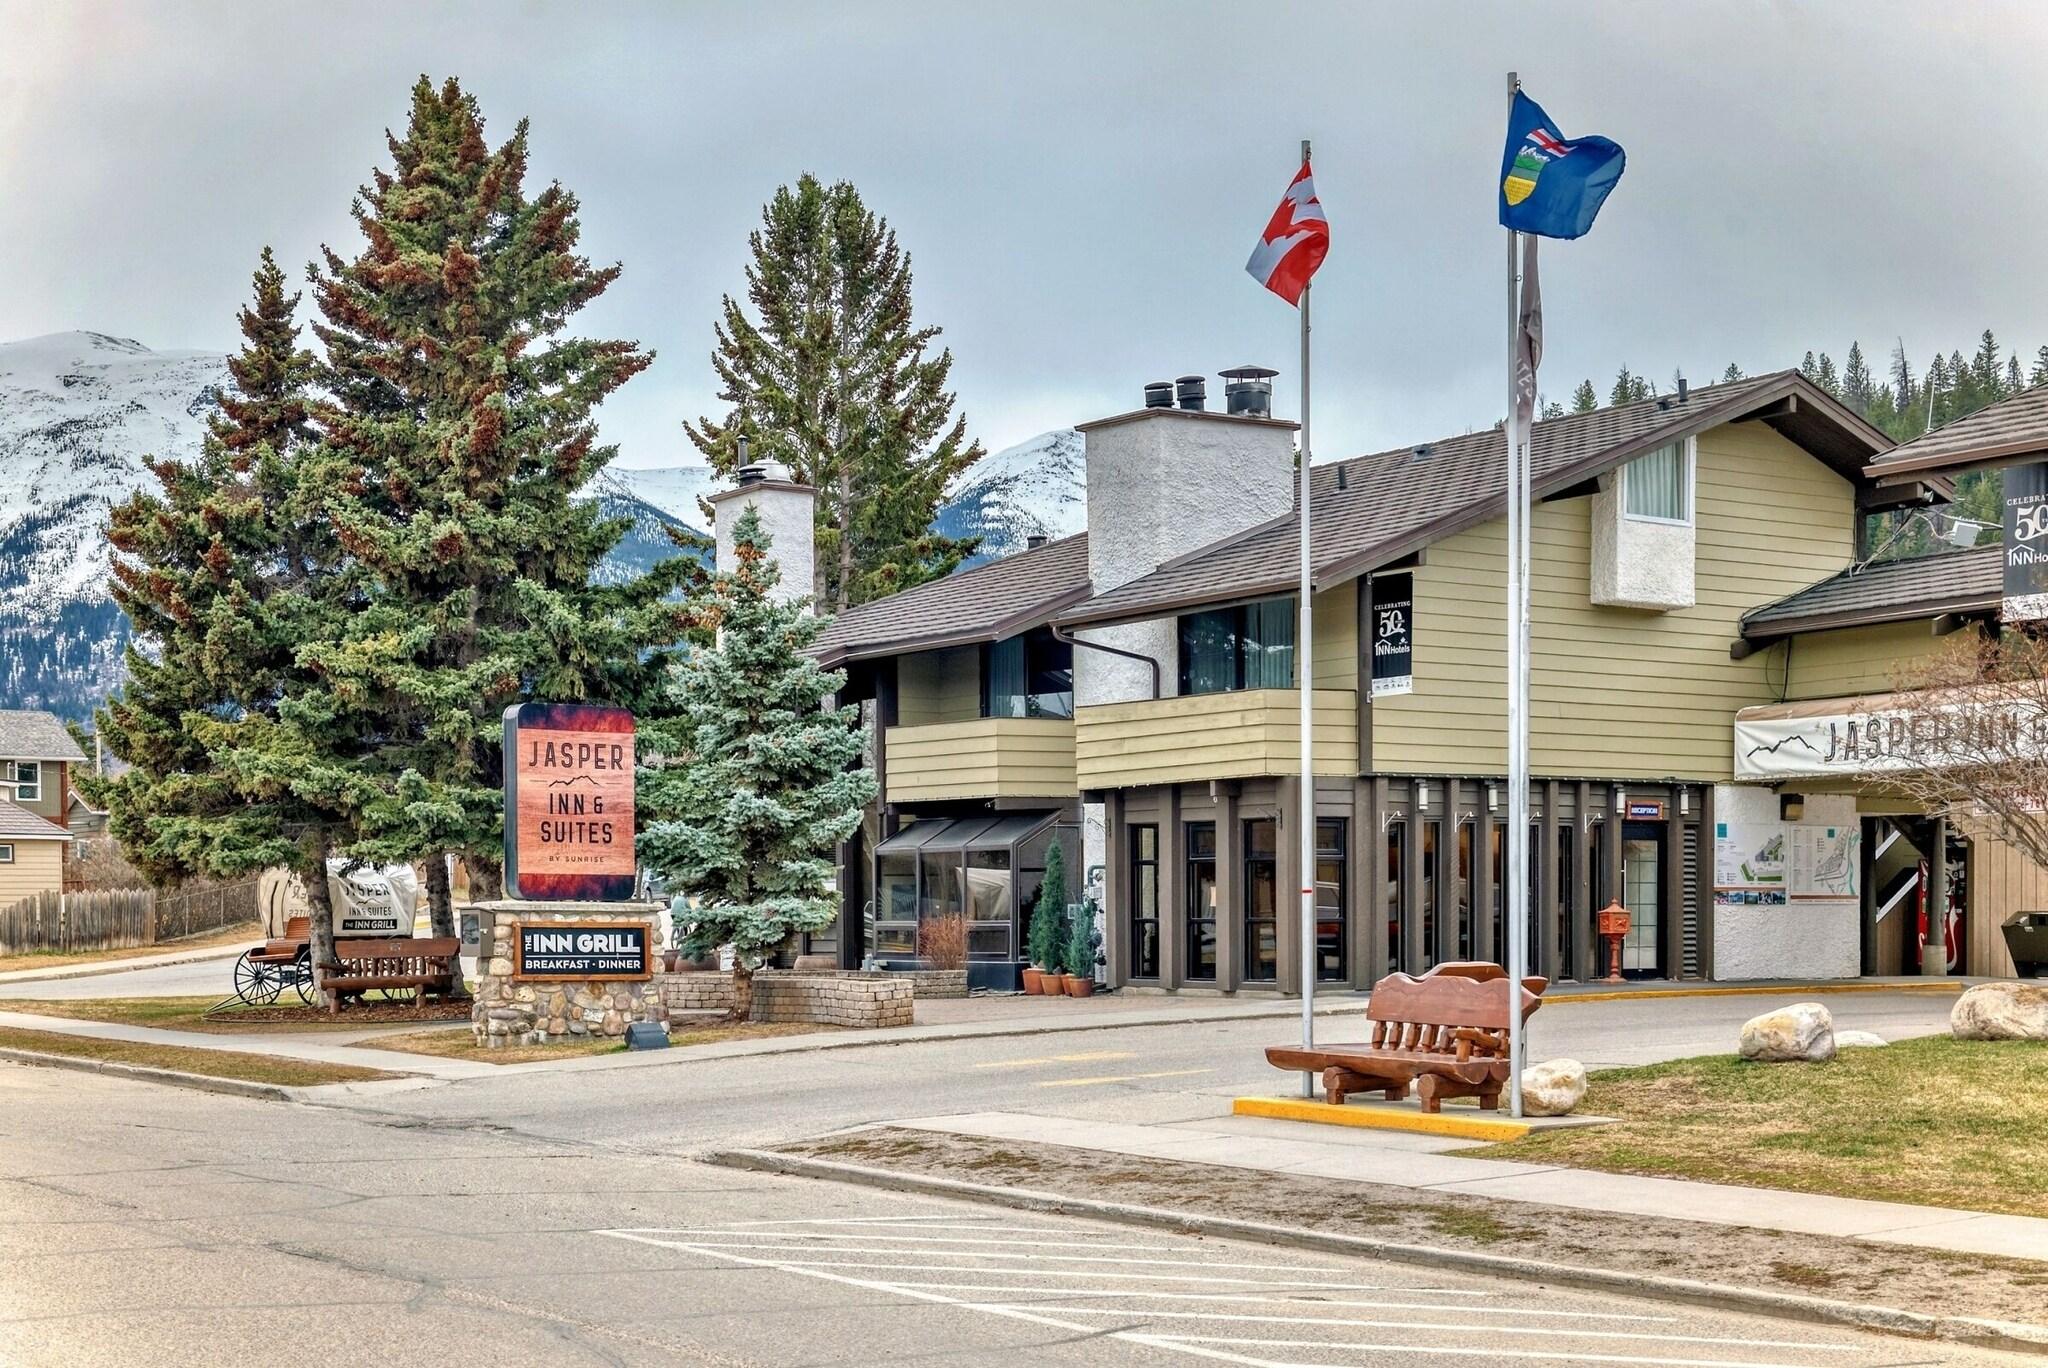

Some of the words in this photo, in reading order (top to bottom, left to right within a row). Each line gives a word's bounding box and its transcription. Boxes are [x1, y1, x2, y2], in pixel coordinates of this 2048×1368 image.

[2007, 494, 2048, 506] CELEBRA
[2015, 505, 2048, 541] 50
[1374, 601, 1411, 610] CELEBRATING
[1379, 610, 1404, 637] 50
[1824, 714, 1949, 762] JASPER
[528, 741, 624, 771] JASPER
[549, 793, 586, 815] INN
[594, 795, 603, 815] &
[540, 821, 613, 844] SUITES
[549, 855, 562, 863] BY
[565, 855, 605, 863] SUNRISE
[368, 906, 392, 916] SUITES
[354, 920, 370, 929] INN
[371, 920, 395, 929] GRILL
[533, 934, 577, 953] INN
[577, 934, 641, 953] GRILL
[525, 960, 590, 969] BREAKFAST
[599, 960, 641, 969] DINNER
